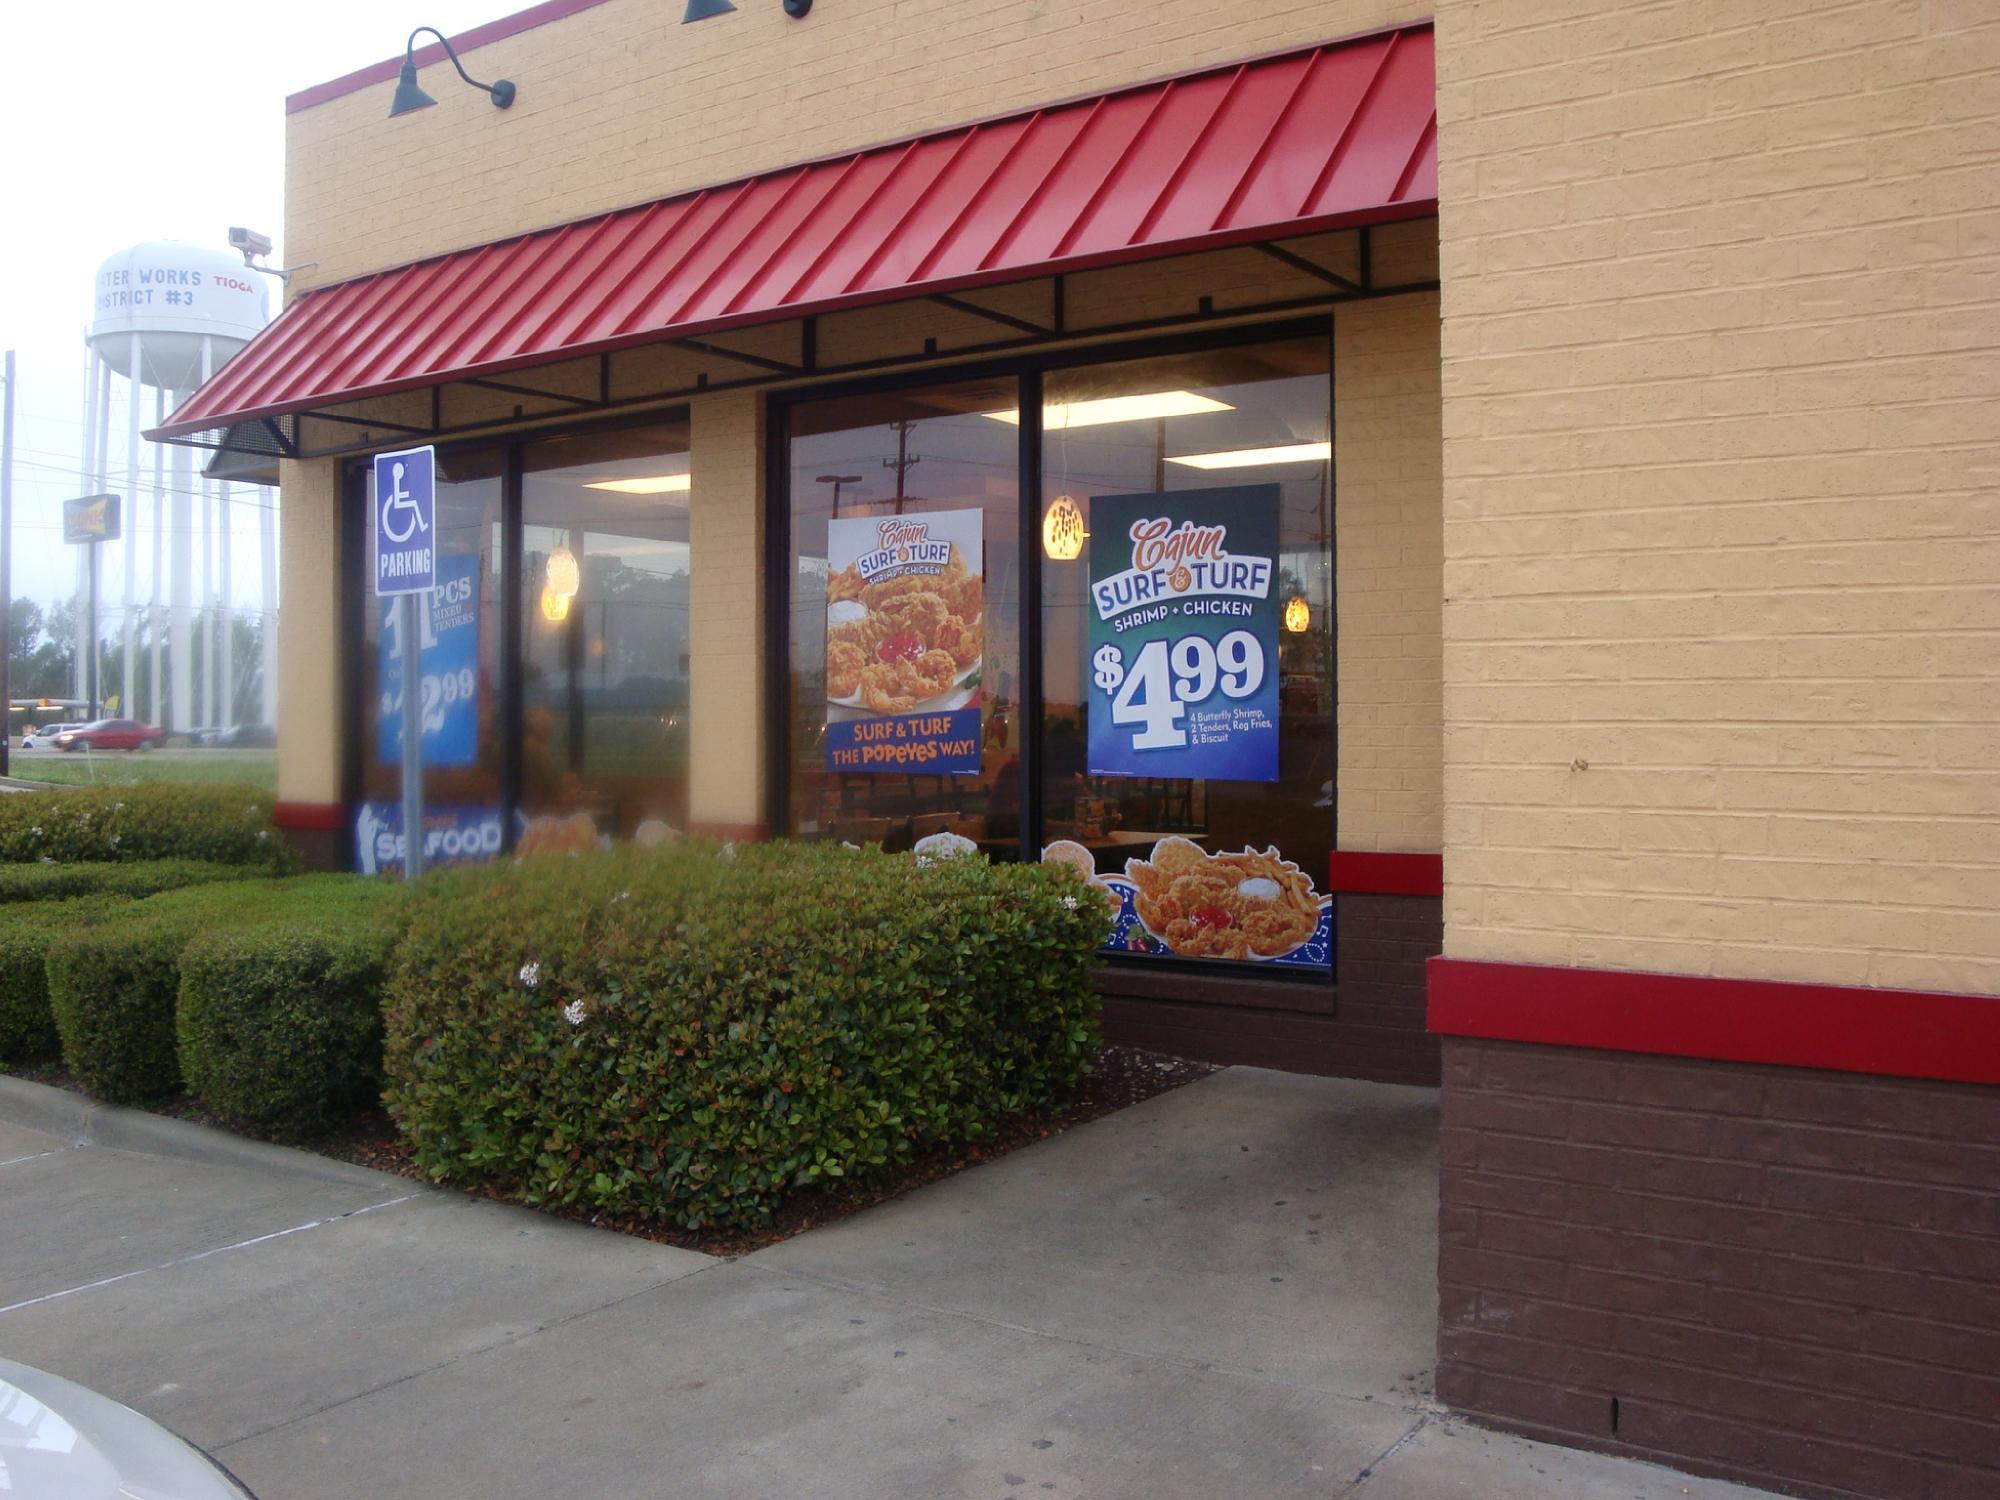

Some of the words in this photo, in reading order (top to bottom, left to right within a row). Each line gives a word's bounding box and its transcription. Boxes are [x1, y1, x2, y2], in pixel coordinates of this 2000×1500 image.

[139, 268, 201, 286] WORKS
[213, 275, 254, 294] TIOGA
[165, 290, 193, 306] #3
[878, 519, 927, 551] Cajun
[1132, 520, 1225, 576] Cajun
[380, 548, 431, 578] PARKING
[861, 548, 898, 575] SURF
[909, 543, 949, 562] TURF
[869, 568, 897, 586] SHRIMP
[904, 565, 941, 577] CHICKEN
[1097, 567, 1167, 612] SURF
[1190, 562, 1268, 591] TURF
[432, 576, 472, 610] PCS
[1114, 605, 1169, 633] SHRIMP
[1183, 600, 1253, 617] CHICKEN
[1190, 712, 1196, 722] 4
[1197, 709, 1231, 722] Butterfly
[1233, 708, 1265, 720] Shrimp,
[1191, 723, 1197, 734] 2
[1198, 722, 1231, 733] Tenders,
[1232, 720, 1249, 732] Reg
[1250, 718, 1273, 729] Fries,
[854, 721, 894, 742] SURF
[896, 722, 906, 738] &
[908, 717, 952, 737] TURF
[1192, 734, 1199, 744] &
[1201, 733, 1229, 744] Biscuit
[832, 749, 859, 766] THE
[939, 739, 976, 757] WAY!
[376, 820, 503, 860] SEFOOD
